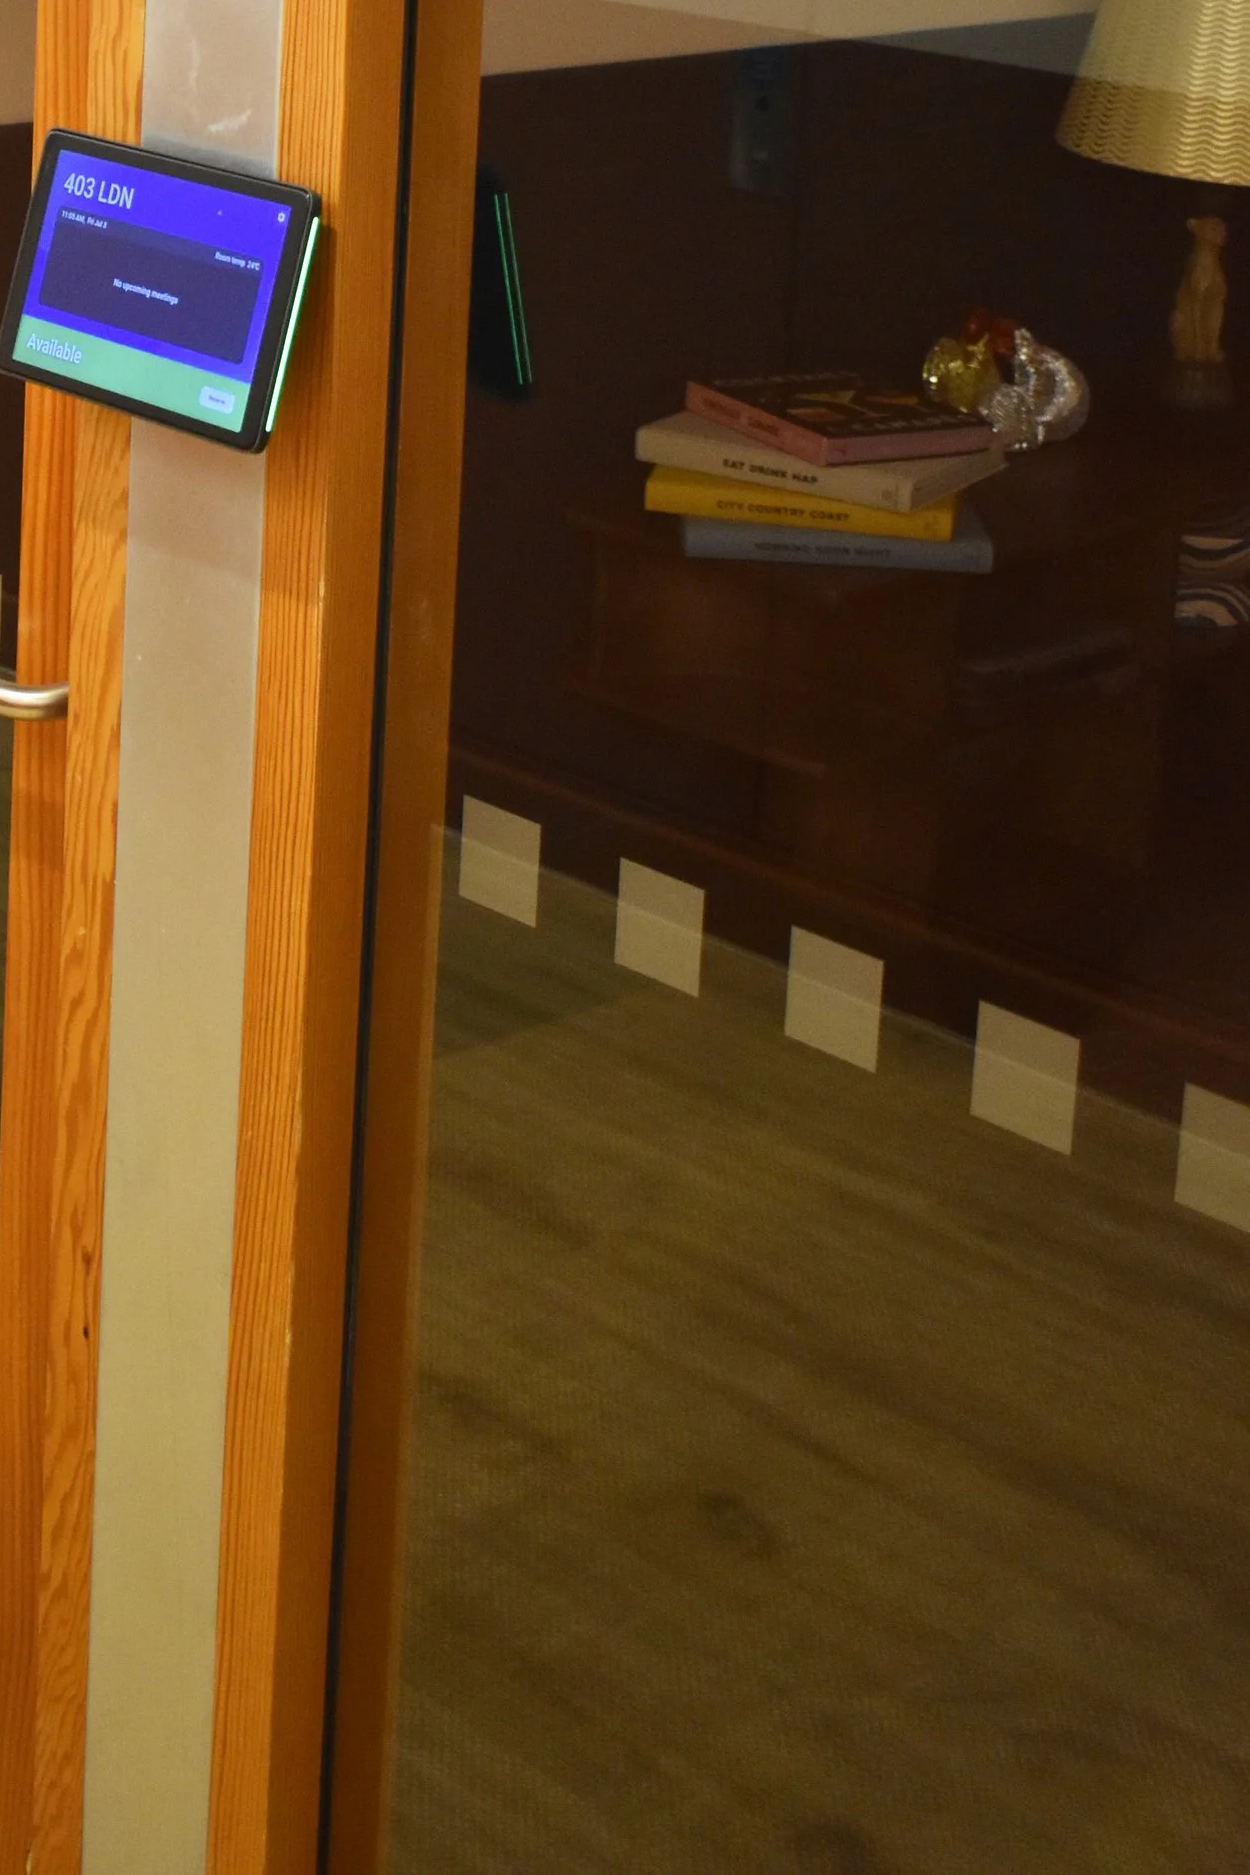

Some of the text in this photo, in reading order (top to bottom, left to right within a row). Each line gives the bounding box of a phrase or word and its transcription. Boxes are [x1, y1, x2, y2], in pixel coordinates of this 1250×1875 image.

[63, 172, 135, 209] 403 LDN
[112, 278, 123, 288] No
[122, 282, 151, 299] upcoming
[26, 332, 83, 365] Available
[723, 458, 745, 471] EAT
[716, 499, 851, 522] CITY COUNTRY COAST
